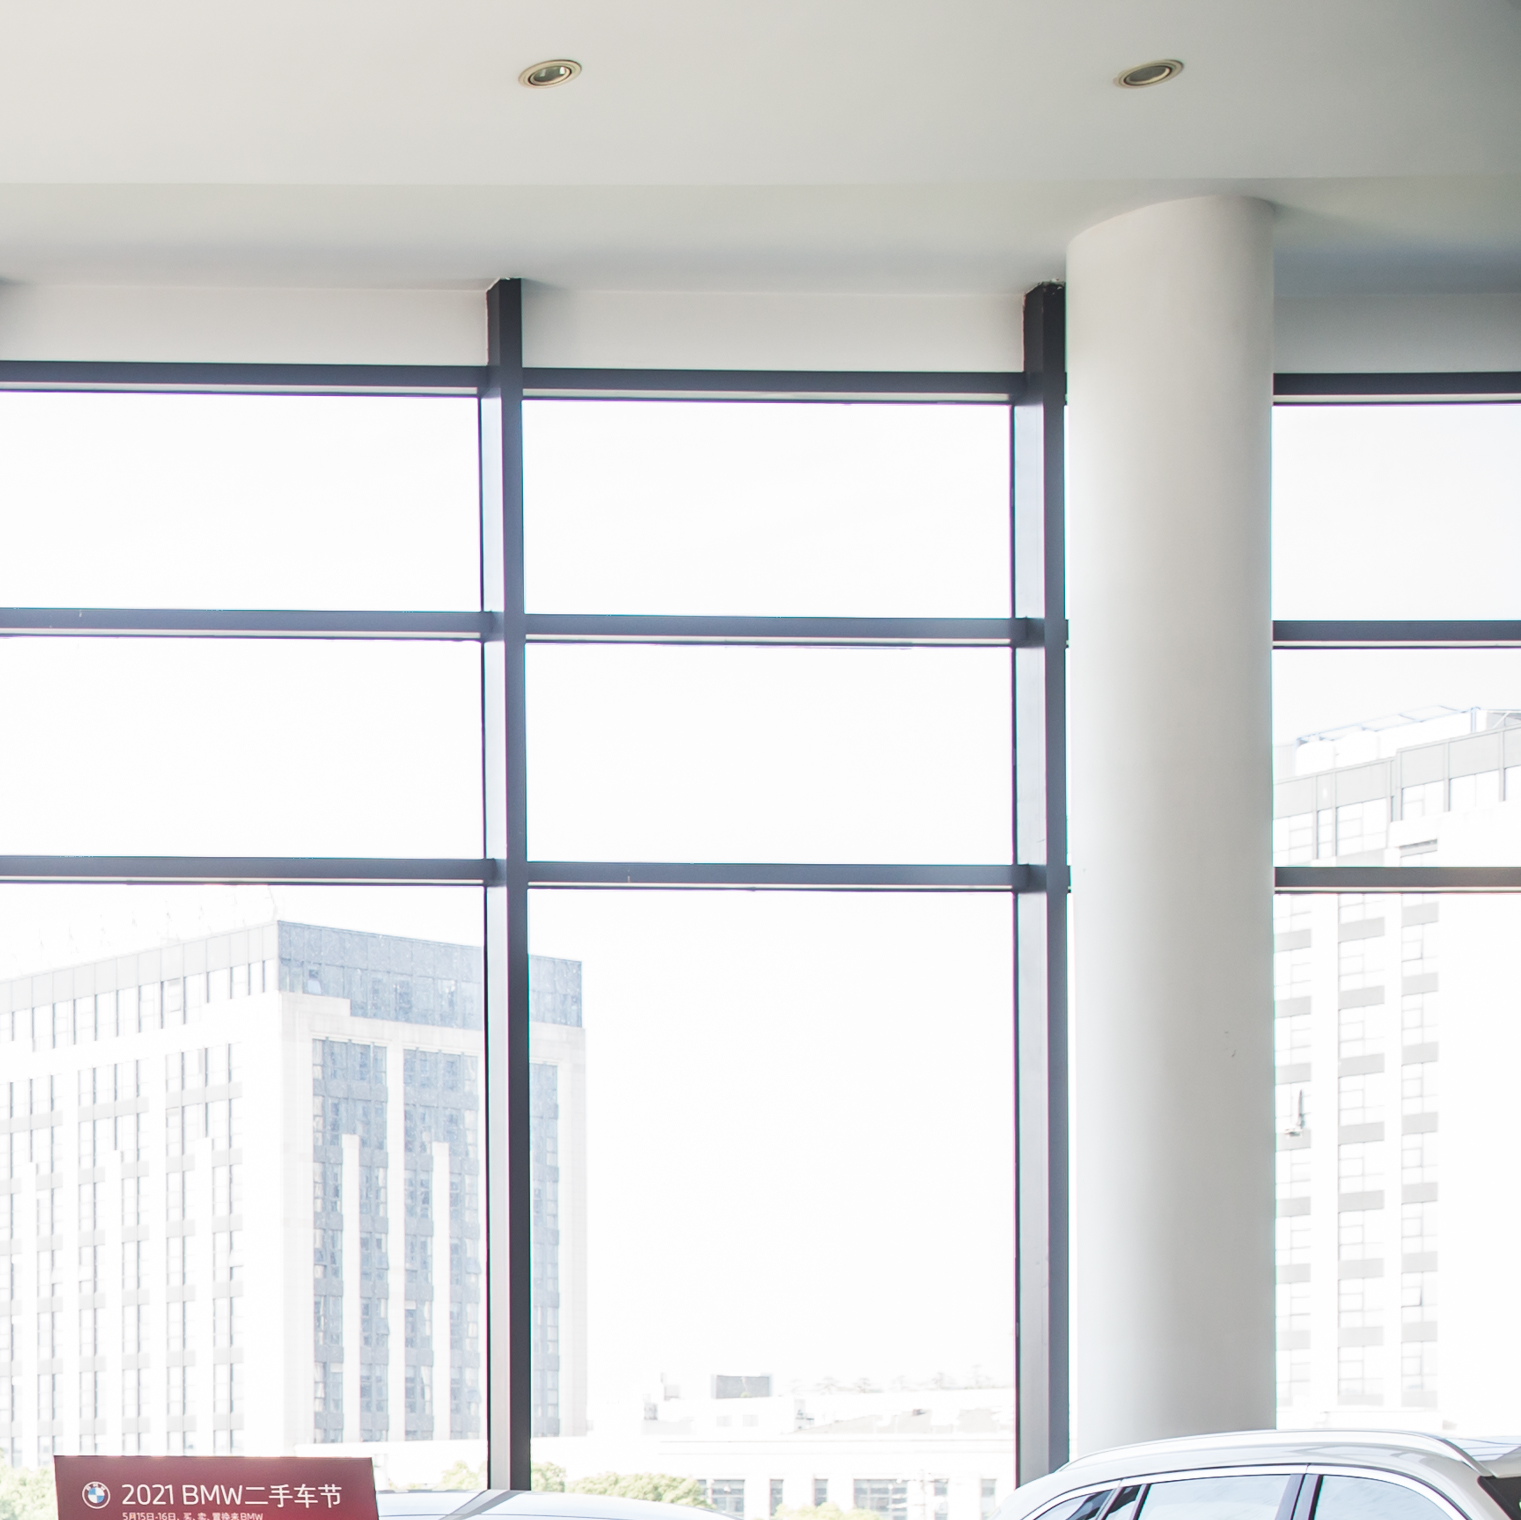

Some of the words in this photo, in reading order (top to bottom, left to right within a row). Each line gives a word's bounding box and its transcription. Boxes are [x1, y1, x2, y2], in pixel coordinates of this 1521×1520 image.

[121, 1484, 174, 1505] 2021
[182, 1484, 342, 1508] BMW二手车节
